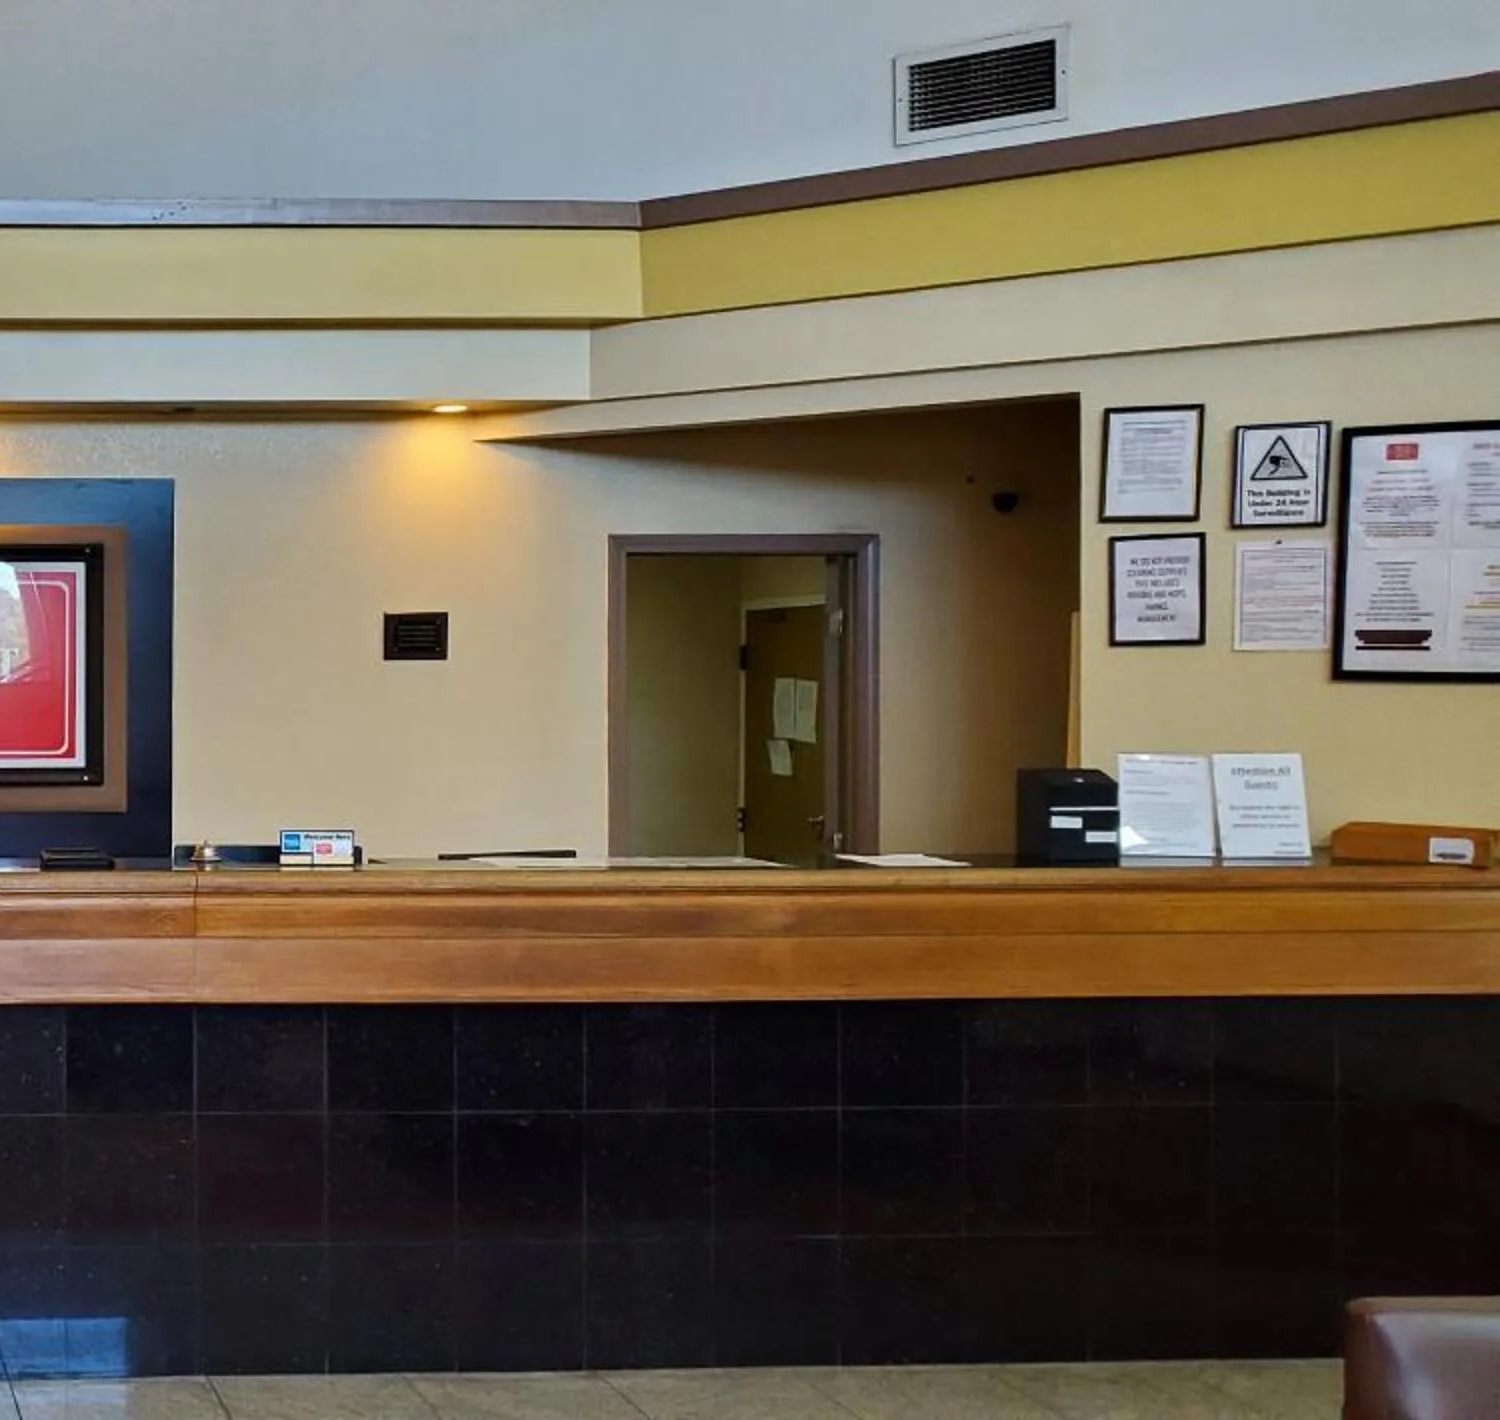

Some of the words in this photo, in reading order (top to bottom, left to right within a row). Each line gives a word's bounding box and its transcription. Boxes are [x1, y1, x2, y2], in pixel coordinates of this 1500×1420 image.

[1265, 488, 1301, 498] Building
[1247, 499, 1273, 507] Under
[1275, 499, 1287, 507] 24
[1253, 509, 1304, 517] Surveillance
